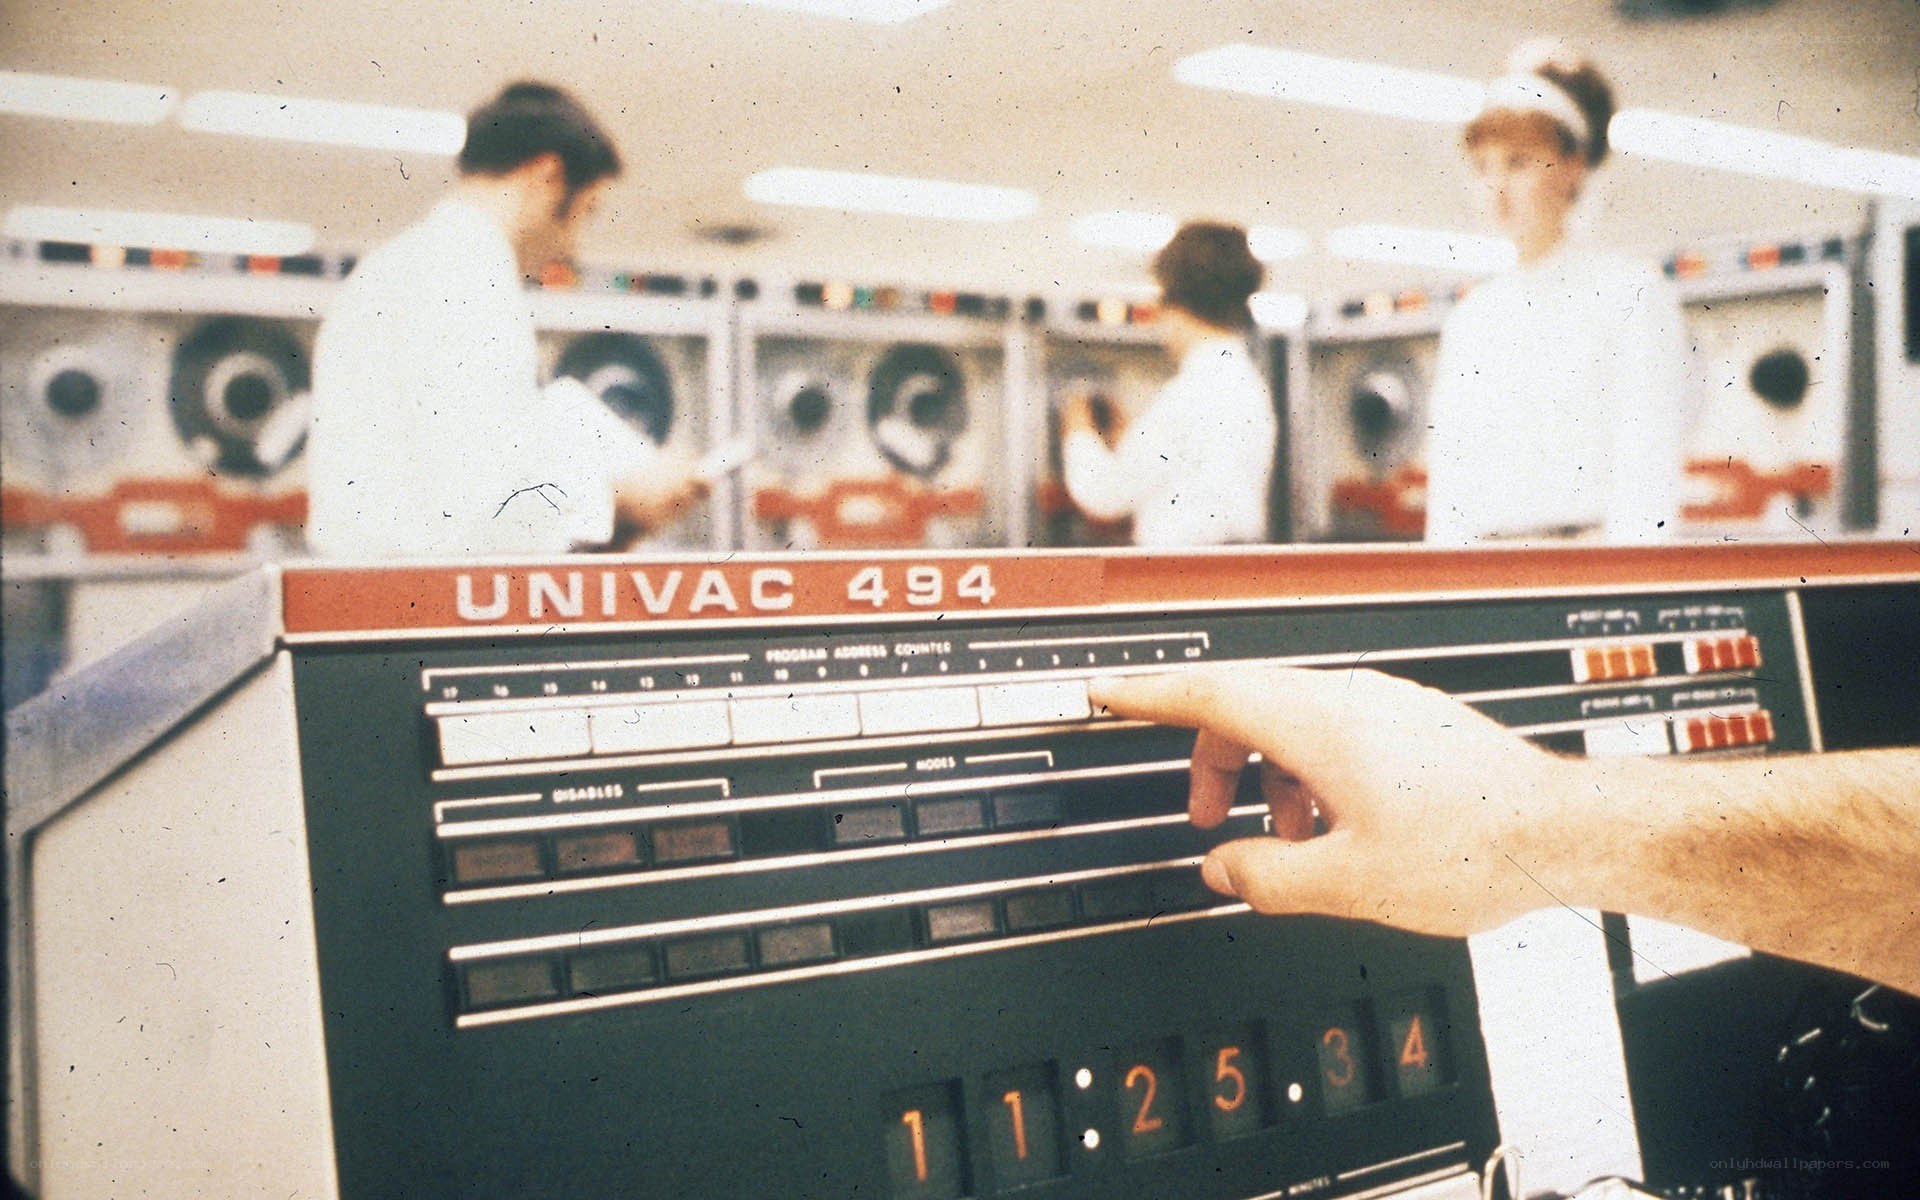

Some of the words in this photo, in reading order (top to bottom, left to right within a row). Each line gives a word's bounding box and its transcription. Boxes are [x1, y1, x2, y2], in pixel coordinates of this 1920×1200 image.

[457, 567, 795, 620] UNIVAC
[847, 565, 996, 607] 494
[765, 648, 828, 663] PROGRAM
[833, 644, 888, 659] ADDRESS
[894, 641, 951, 656] COUNTER
[915, 756, 956, 771] MODES
[552, 783, 624, 803] DISABLES
